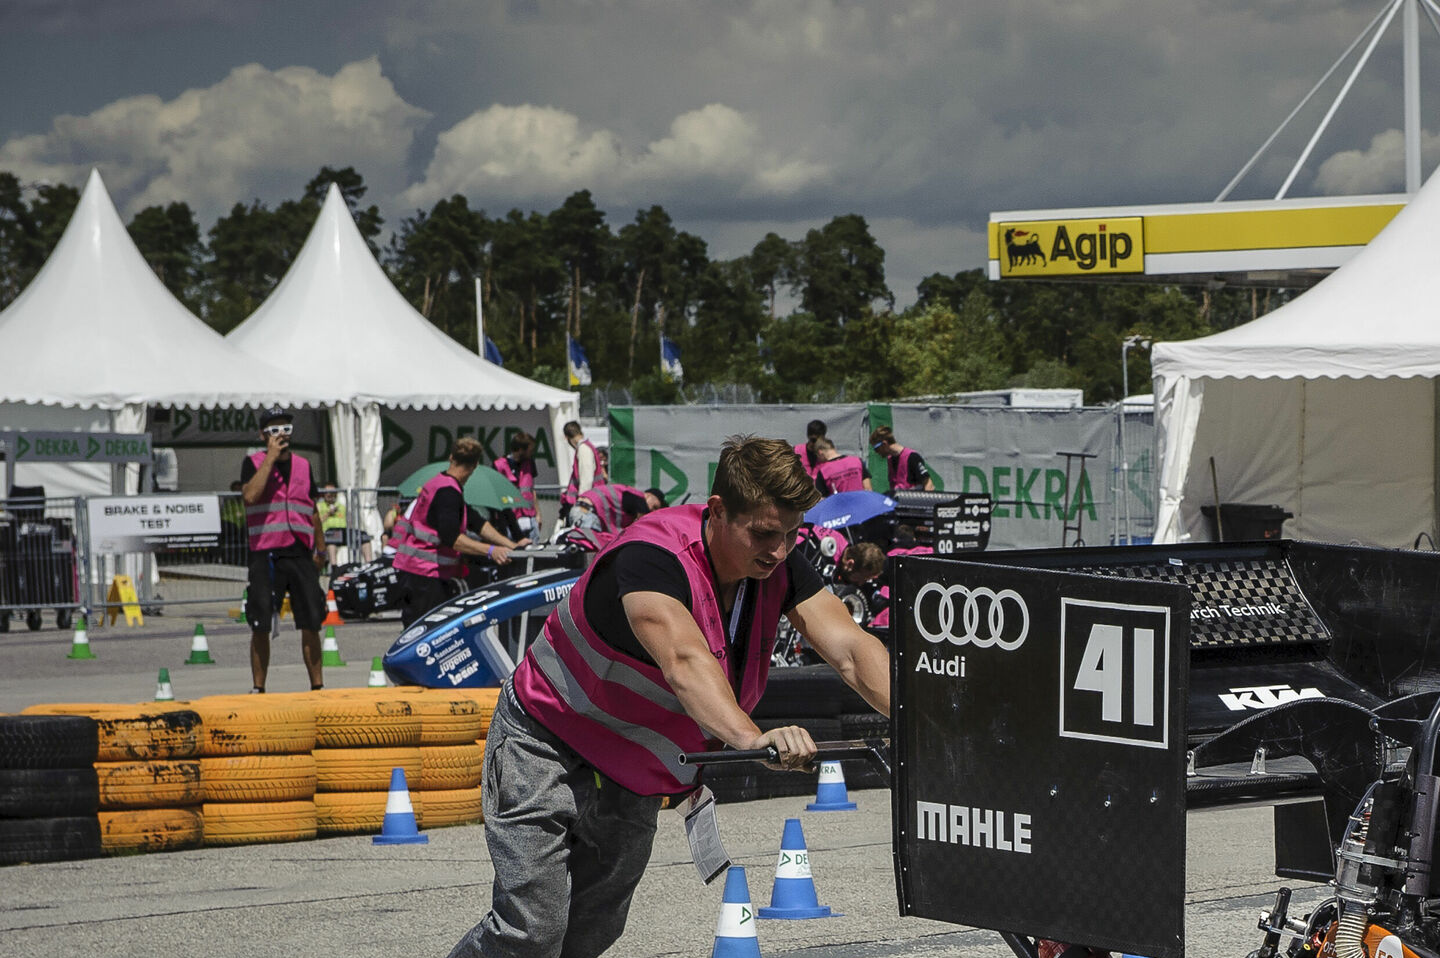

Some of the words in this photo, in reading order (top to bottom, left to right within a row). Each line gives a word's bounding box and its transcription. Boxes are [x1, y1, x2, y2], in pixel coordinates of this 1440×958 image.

[1050, 223, 1133, 270] Agip
[200, 411, 258, 432] DEKRA
[35, 439, 80, 456] DEKRA
[105, 440, 149, 456] DEKRA
[963, 464, 1098, 522] DEKRA
[104, 505, 148, 516] BRAKE
[153, 504, 161, 515] &
[166, 503, 205, 514] NOISE
[140, 519, 171, 529] TEST
[543, 587, 556, 602] TU
[1219, 602, 1286, 617] Technik
[915, 651, 966, 677] Audi
[1073, 623, 1154, 726] 41
[1218, 684, 1327, 711] KTM
[917, 800, 1032, 854] MAHLE
